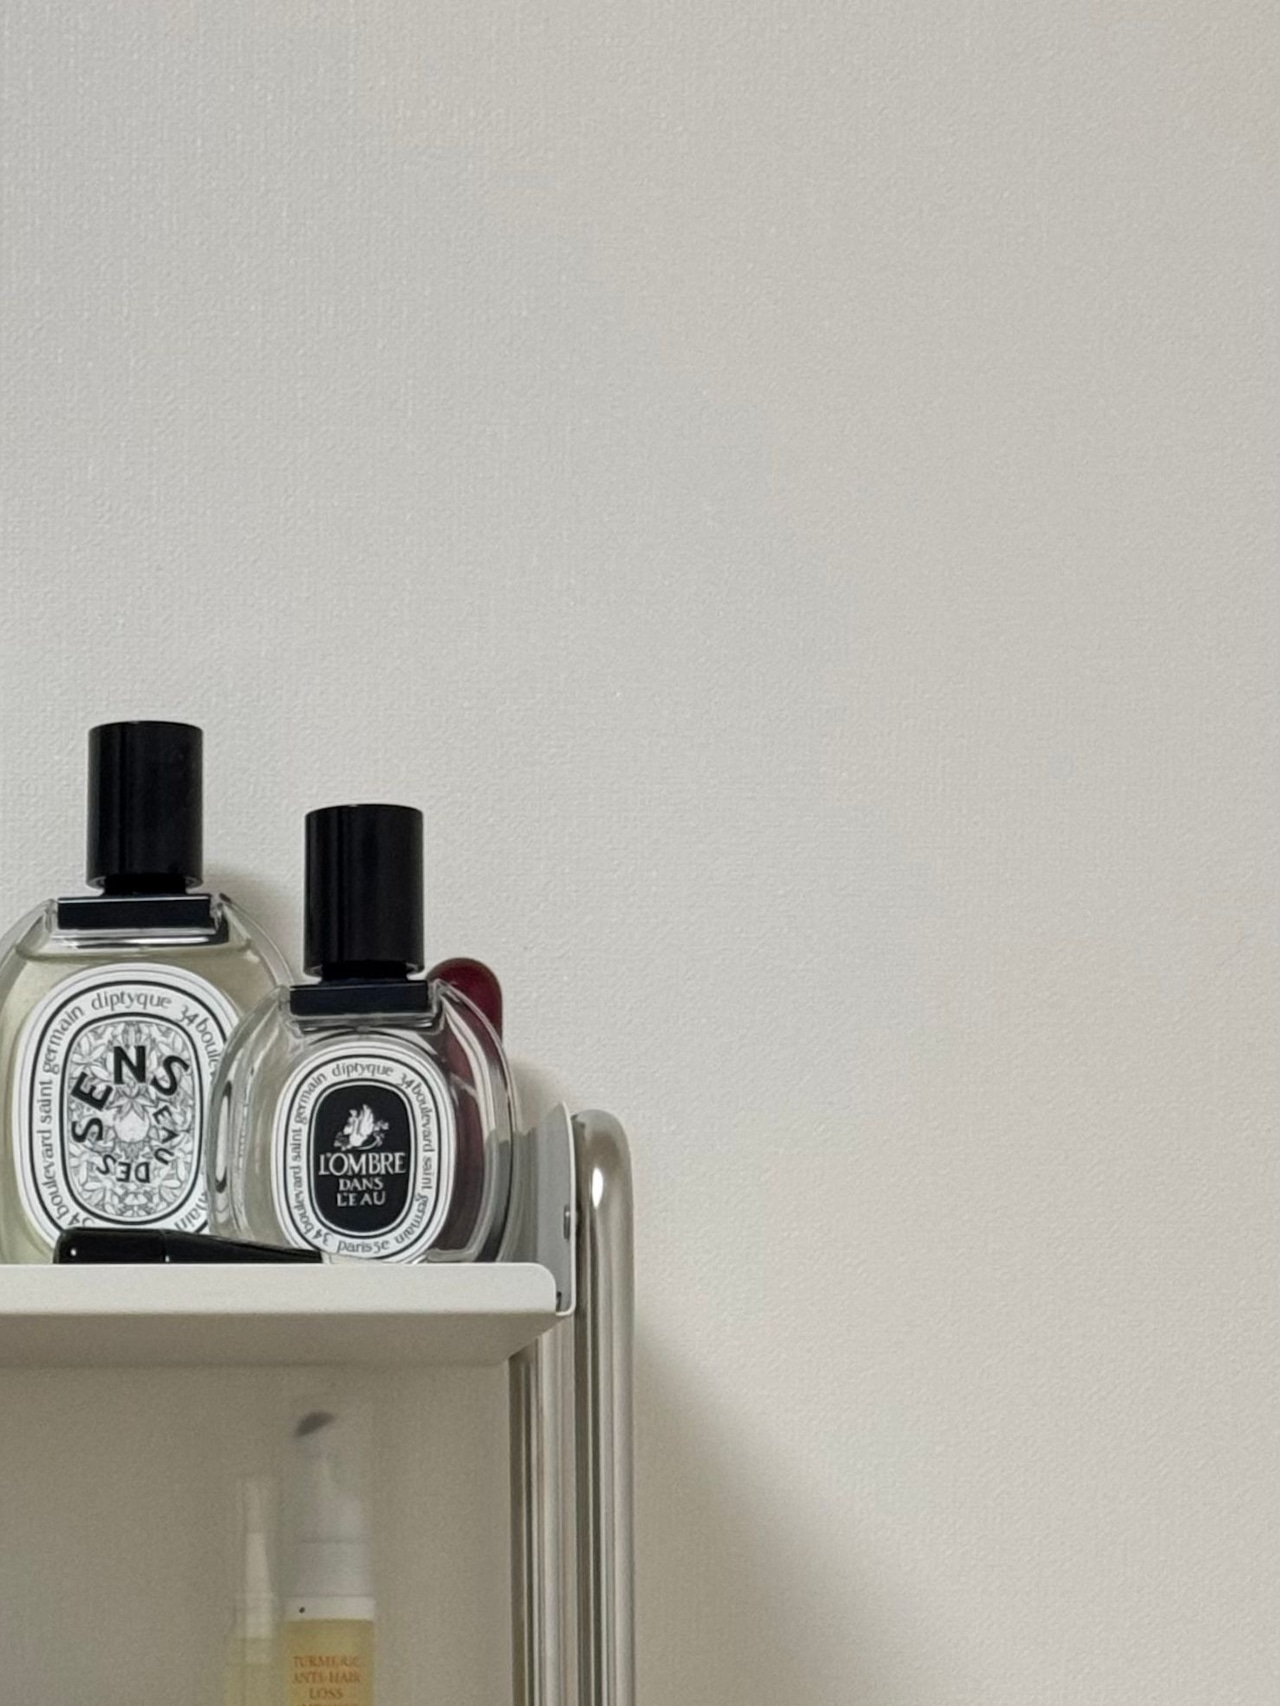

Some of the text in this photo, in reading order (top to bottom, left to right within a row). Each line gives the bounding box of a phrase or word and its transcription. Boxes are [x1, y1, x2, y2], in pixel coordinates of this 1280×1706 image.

[90, 989, 173, 1012] diptyque
[176, 1004, 200, 1027] 34
[42, 1004, 85, 1075] germain
[331, 1062, 394, 1078] diptyque
[37, 1079, 53, 1125] saint
[70, 1045, 190, 1144] SENS
[293, 1073, 327, 1125] germain
[152, 1105, 181, 1166] EAU
[289, 1128, 302, 1162] saint
[36, 1129, 70, 1220] boulevard
[96, 1153, 151, 1184] DES
[319, 1152, 407, 1176] L'OMBRE
[394, 1073, 436, 1244] 34 boulevard saint germain
[289, 1165, 315, 1235] boulevard
[336, 1190, 386, 1207] L'EAU
[339, 1177, 384, 1192] DANS
[309, 1687, 344, 1700] LOSS
